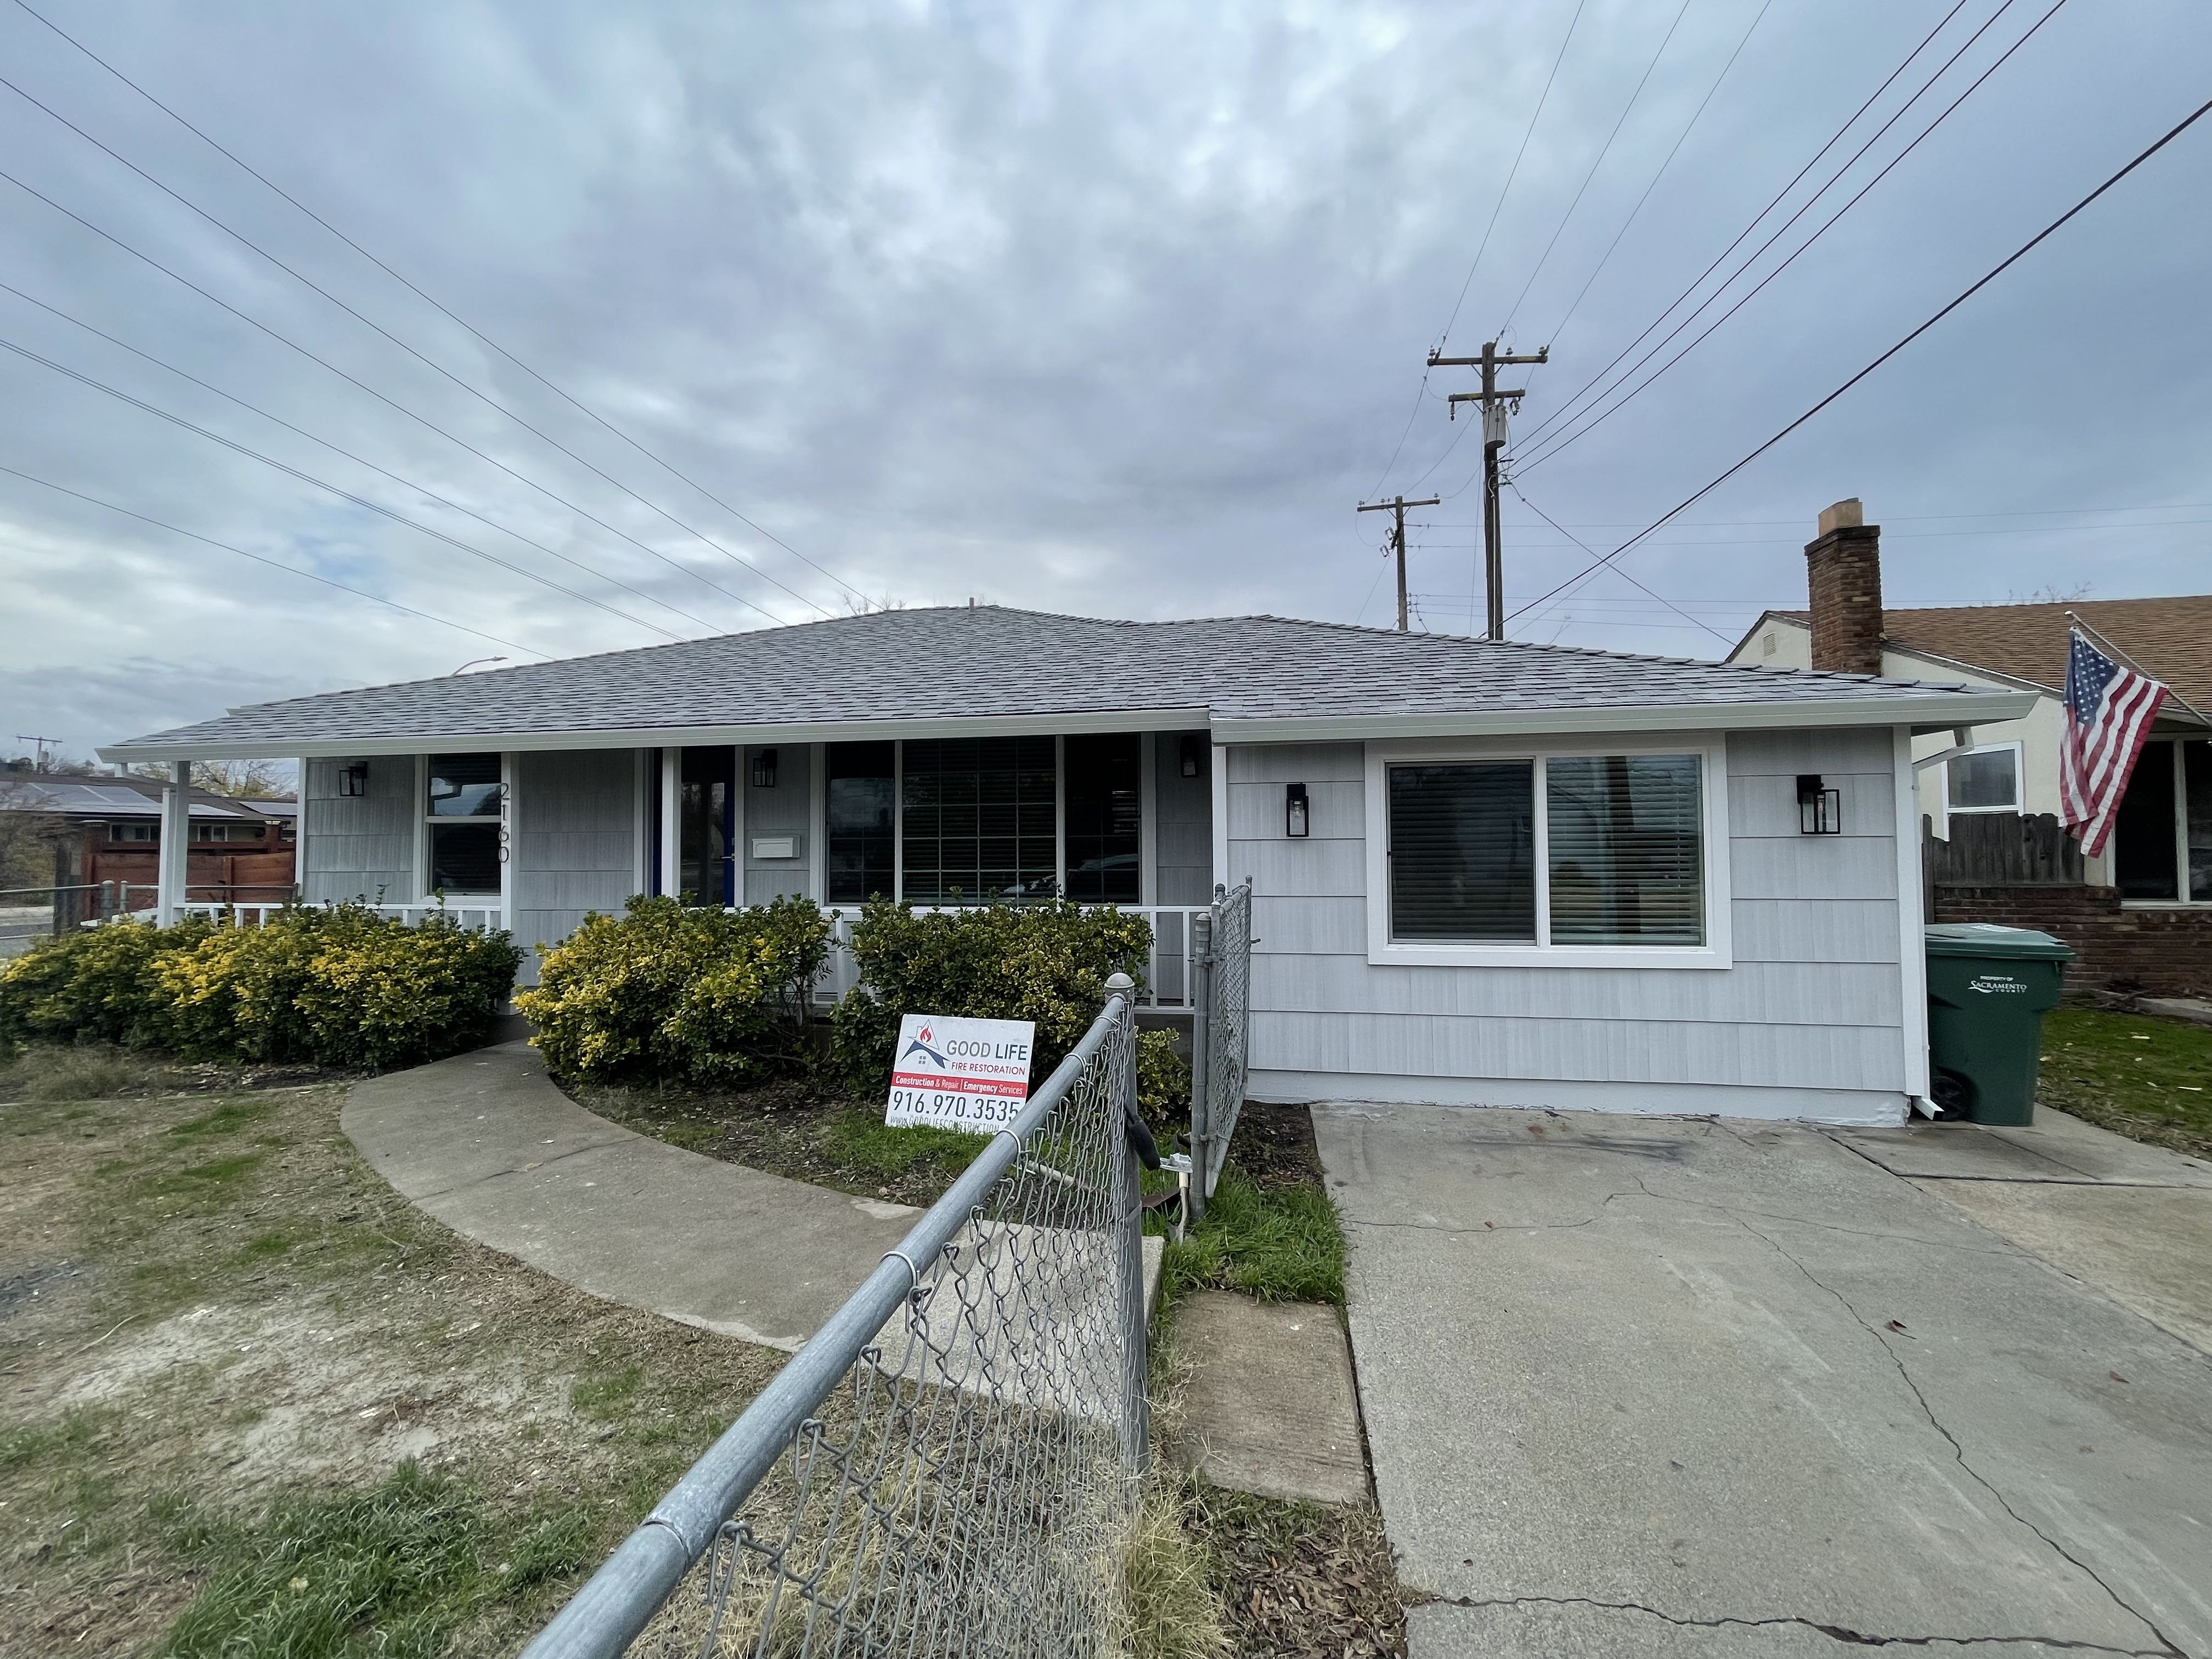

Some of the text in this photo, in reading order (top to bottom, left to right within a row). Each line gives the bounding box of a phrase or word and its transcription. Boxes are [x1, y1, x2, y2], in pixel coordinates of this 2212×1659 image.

[498, 783, 510, 863] 2160
[1971, 980, 2027, 990] SACRAMENTO
[947, 1040, 1028, 1061] GOOD LIFE
[951, 1062, 1026, 1075] FIRE RESTORATION
[895, 1075, 934, 1087] Construction
[941, 1079, 959, 1090] Repair
[963, 1081, 998, 1093] Emergency
[998, 1085, 1023, 1095] Services
[893, 1091, 1020, 1122] 916.970.3535
